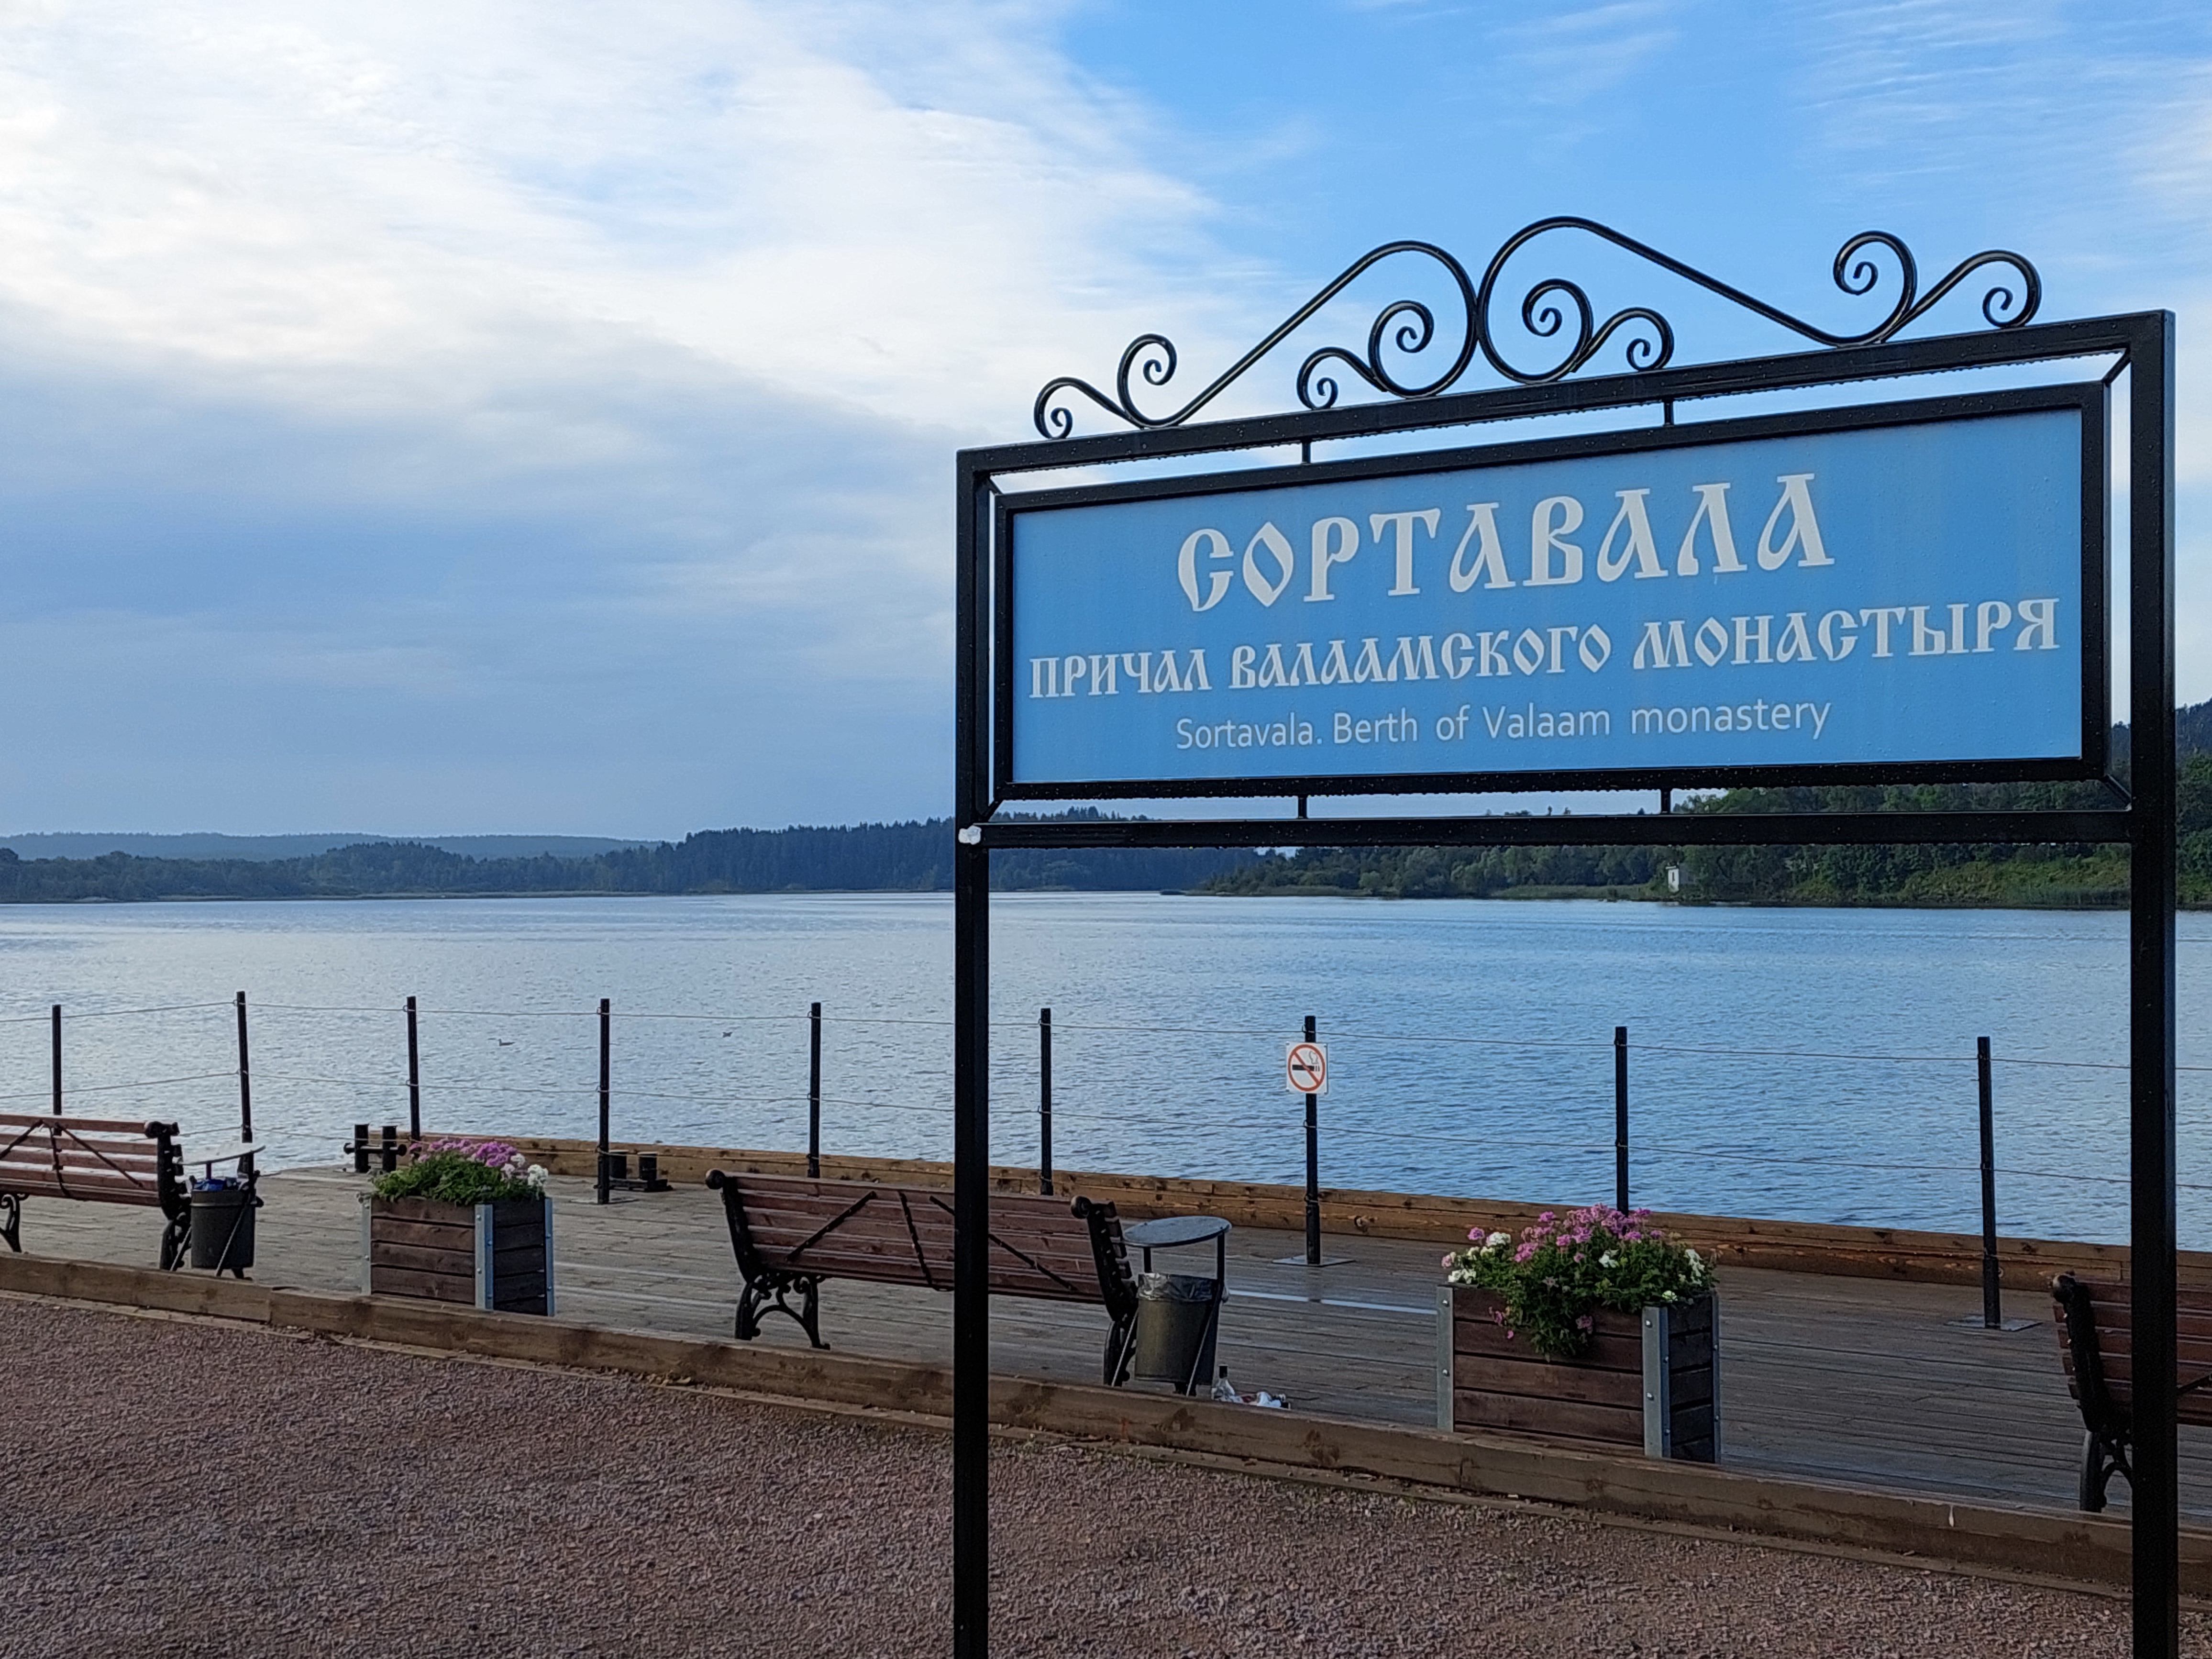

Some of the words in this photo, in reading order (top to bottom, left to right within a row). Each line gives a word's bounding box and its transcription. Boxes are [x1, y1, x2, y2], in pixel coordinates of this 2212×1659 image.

[1177, 473, 1834, 611] СОРТАВАЛА
[1029, 648, 1212, 698] ПРИЧАЛ
[1229, 624, 1611, 689] ВАЛААМСКОГО
[1633, 598, 2058, 670] МОНАСТЫРЯ
[1176, 712, 1323, 749] Sortavala.
[1333, 707, 1418, 744] Berth
[1436, 704, 1471, 741] of
[1482, 703, 1610, 738] Valaam
[1631, 698, 1831, 740] monastery
